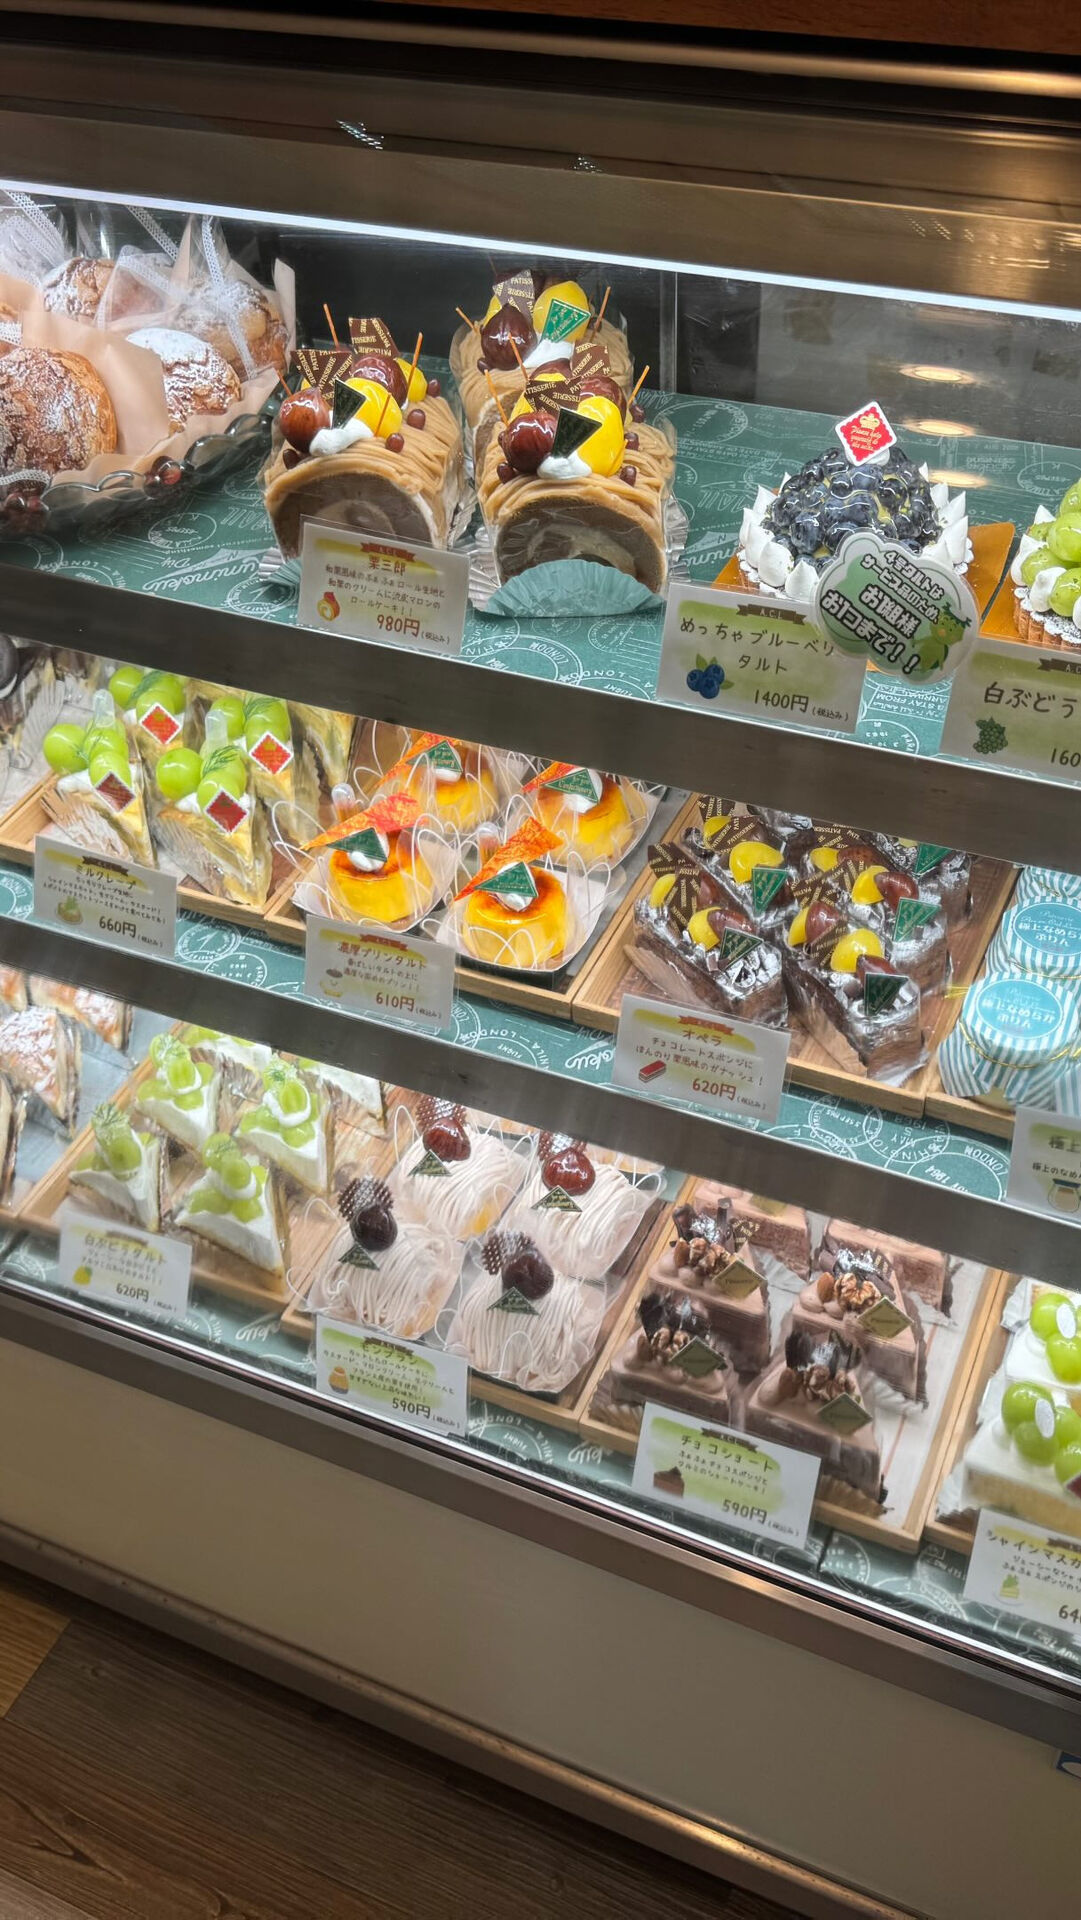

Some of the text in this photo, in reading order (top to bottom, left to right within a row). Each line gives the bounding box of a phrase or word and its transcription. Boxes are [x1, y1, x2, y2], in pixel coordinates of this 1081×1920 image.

[884, 550, 945, 600] 4号タルトは
[860, 553, 940, 624] サービス品のため、
[377, 613, 421, 638] 980円
[738, 653, 788, 675] タルト
[753, 689, 809, 713] 1400円
[983, 681, 1078, 719] 白ぶどう
[99, 915, 137, 939] 660円
[376, 991, 415, 1013] 610円
[683, 1028, 722, 1047] オペラ
[652, 1037, 753, 1070] チョコレートスポンジに
[692, 1078, 737, 1101] 620円
[1032, 1161, 1081, 1180] 極上のなめ
[392, 1397, 431, 1419] 590円
[681, 1434, 774, 1473] チョコショート
[722, 1499, 768, 1526] 590円
[1058, 1604, 1081, 1624] 64
